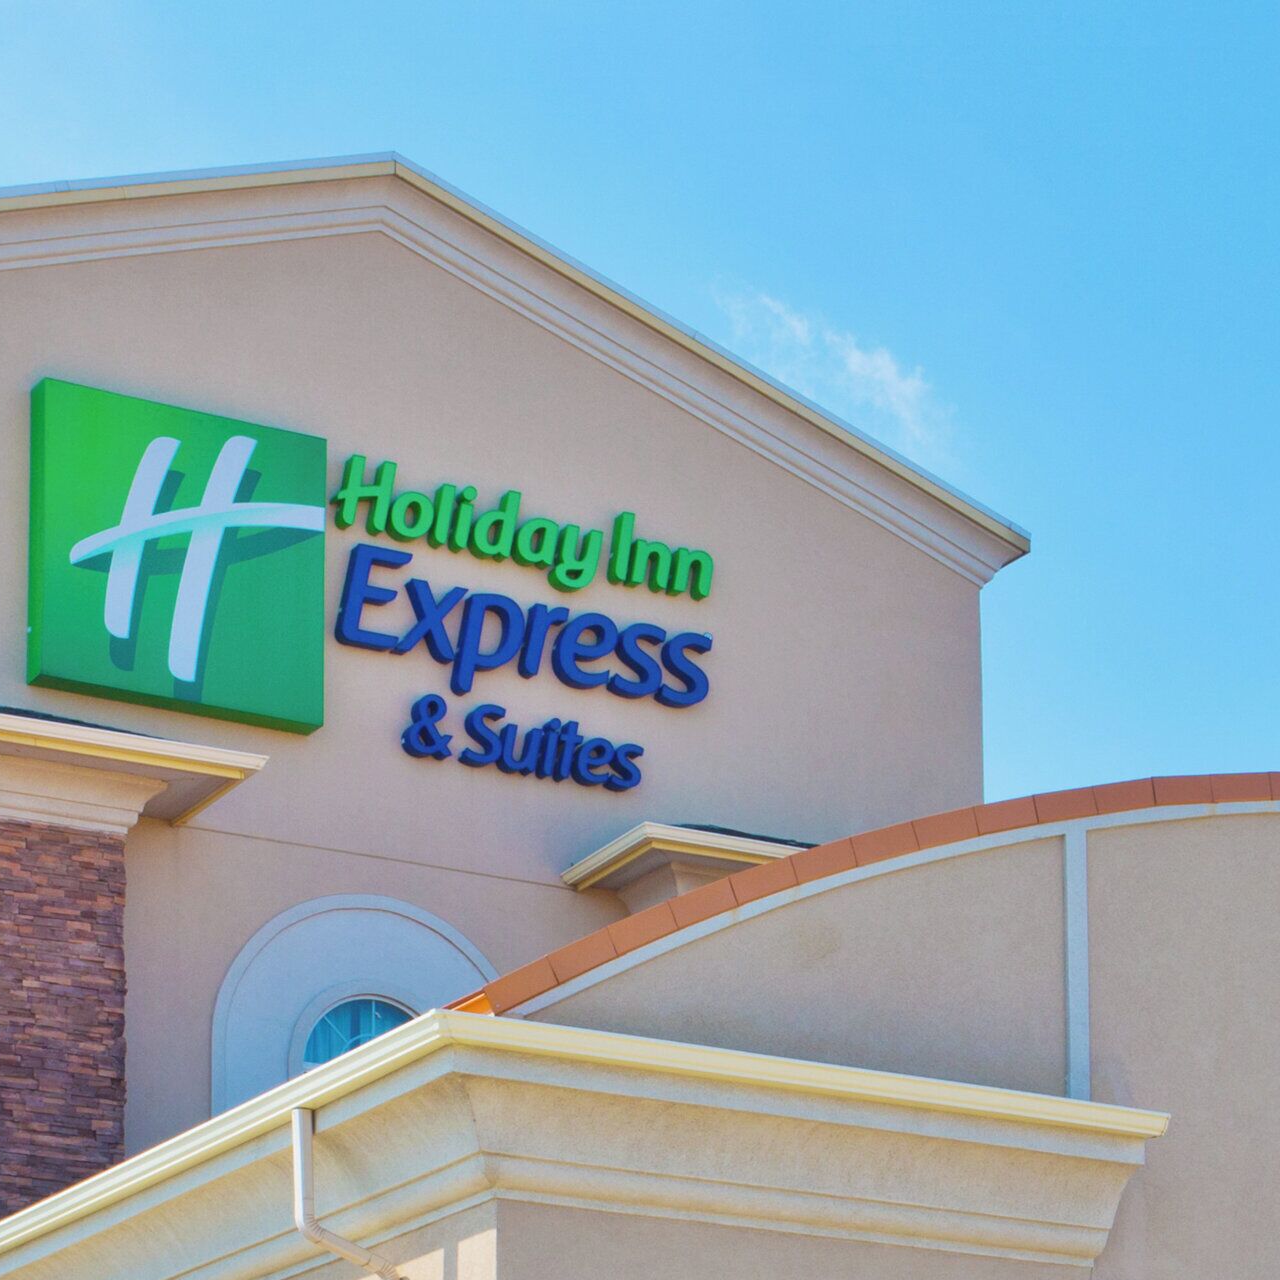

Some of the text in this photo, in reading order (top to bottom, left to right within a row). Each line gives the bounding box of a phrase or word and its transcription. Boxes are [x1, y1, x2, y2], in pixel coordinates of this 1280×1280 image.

[331, 454, 714, 601] Holiday Inn
[334, 543, 713, 708] Express
[401, 694, 645, 792] & Suites
